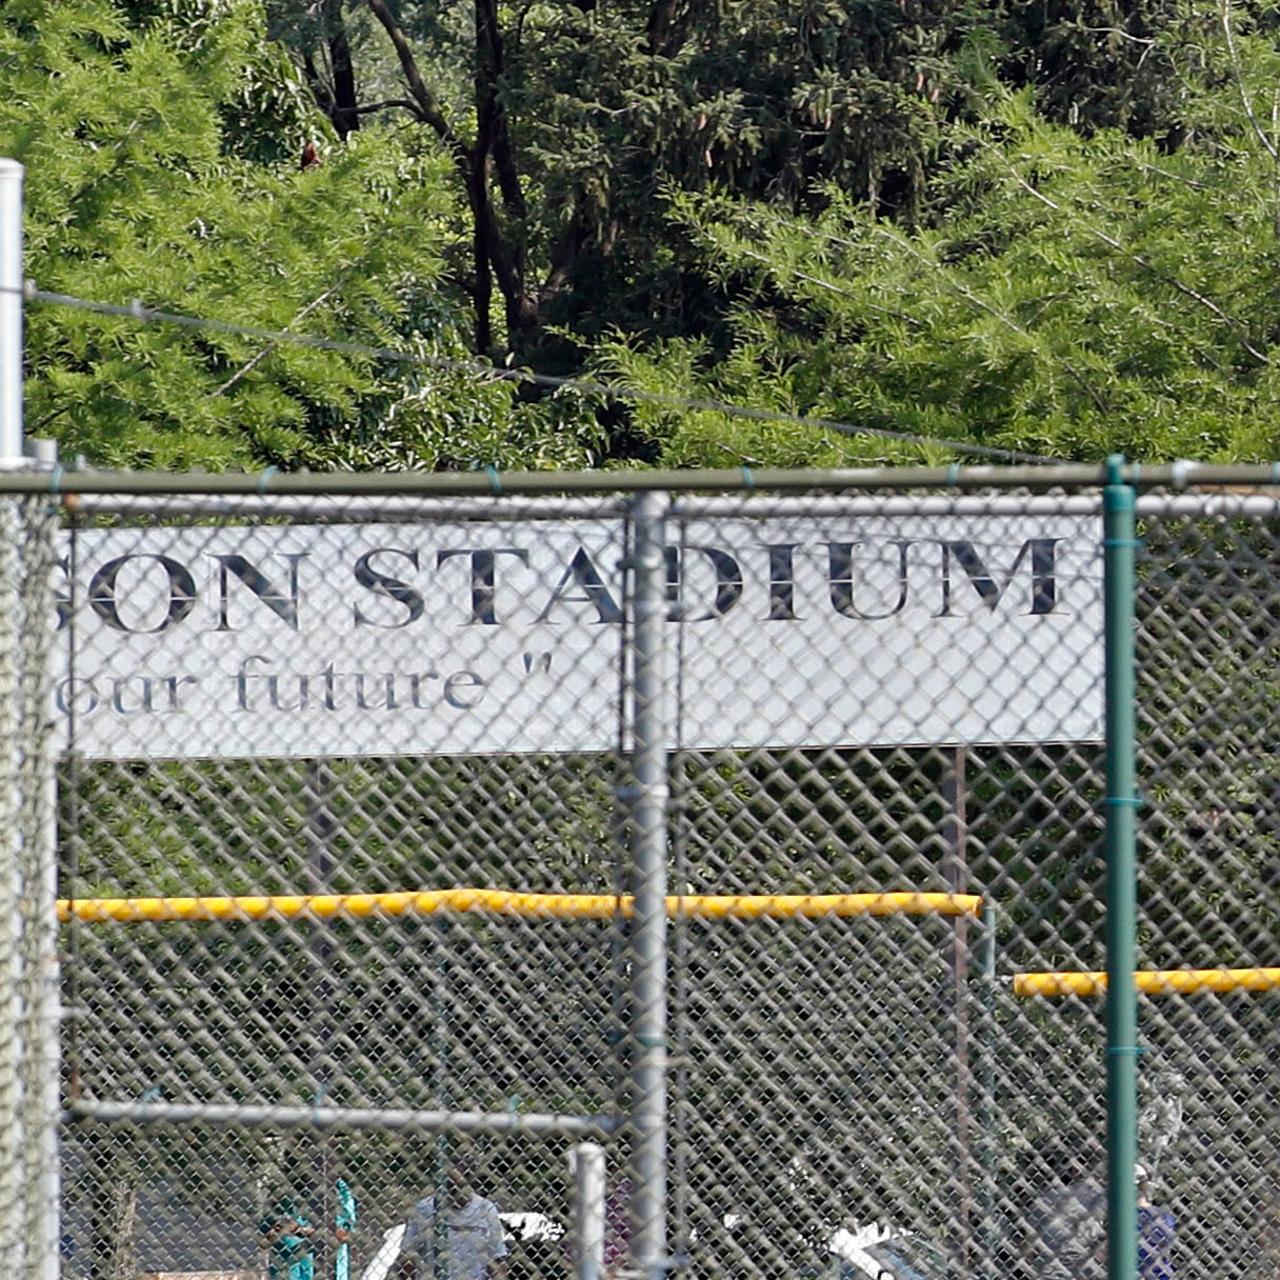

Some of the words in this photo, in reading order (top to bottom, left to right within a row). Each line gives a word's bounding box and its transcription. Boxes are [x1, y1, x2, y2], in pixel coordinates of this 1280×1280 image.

[55, 553, 307, 634] ON
[354, 536, 1071, 629] STADIUM
[55, 676, 198, 716] our
[230, 656, 486, 714] future
